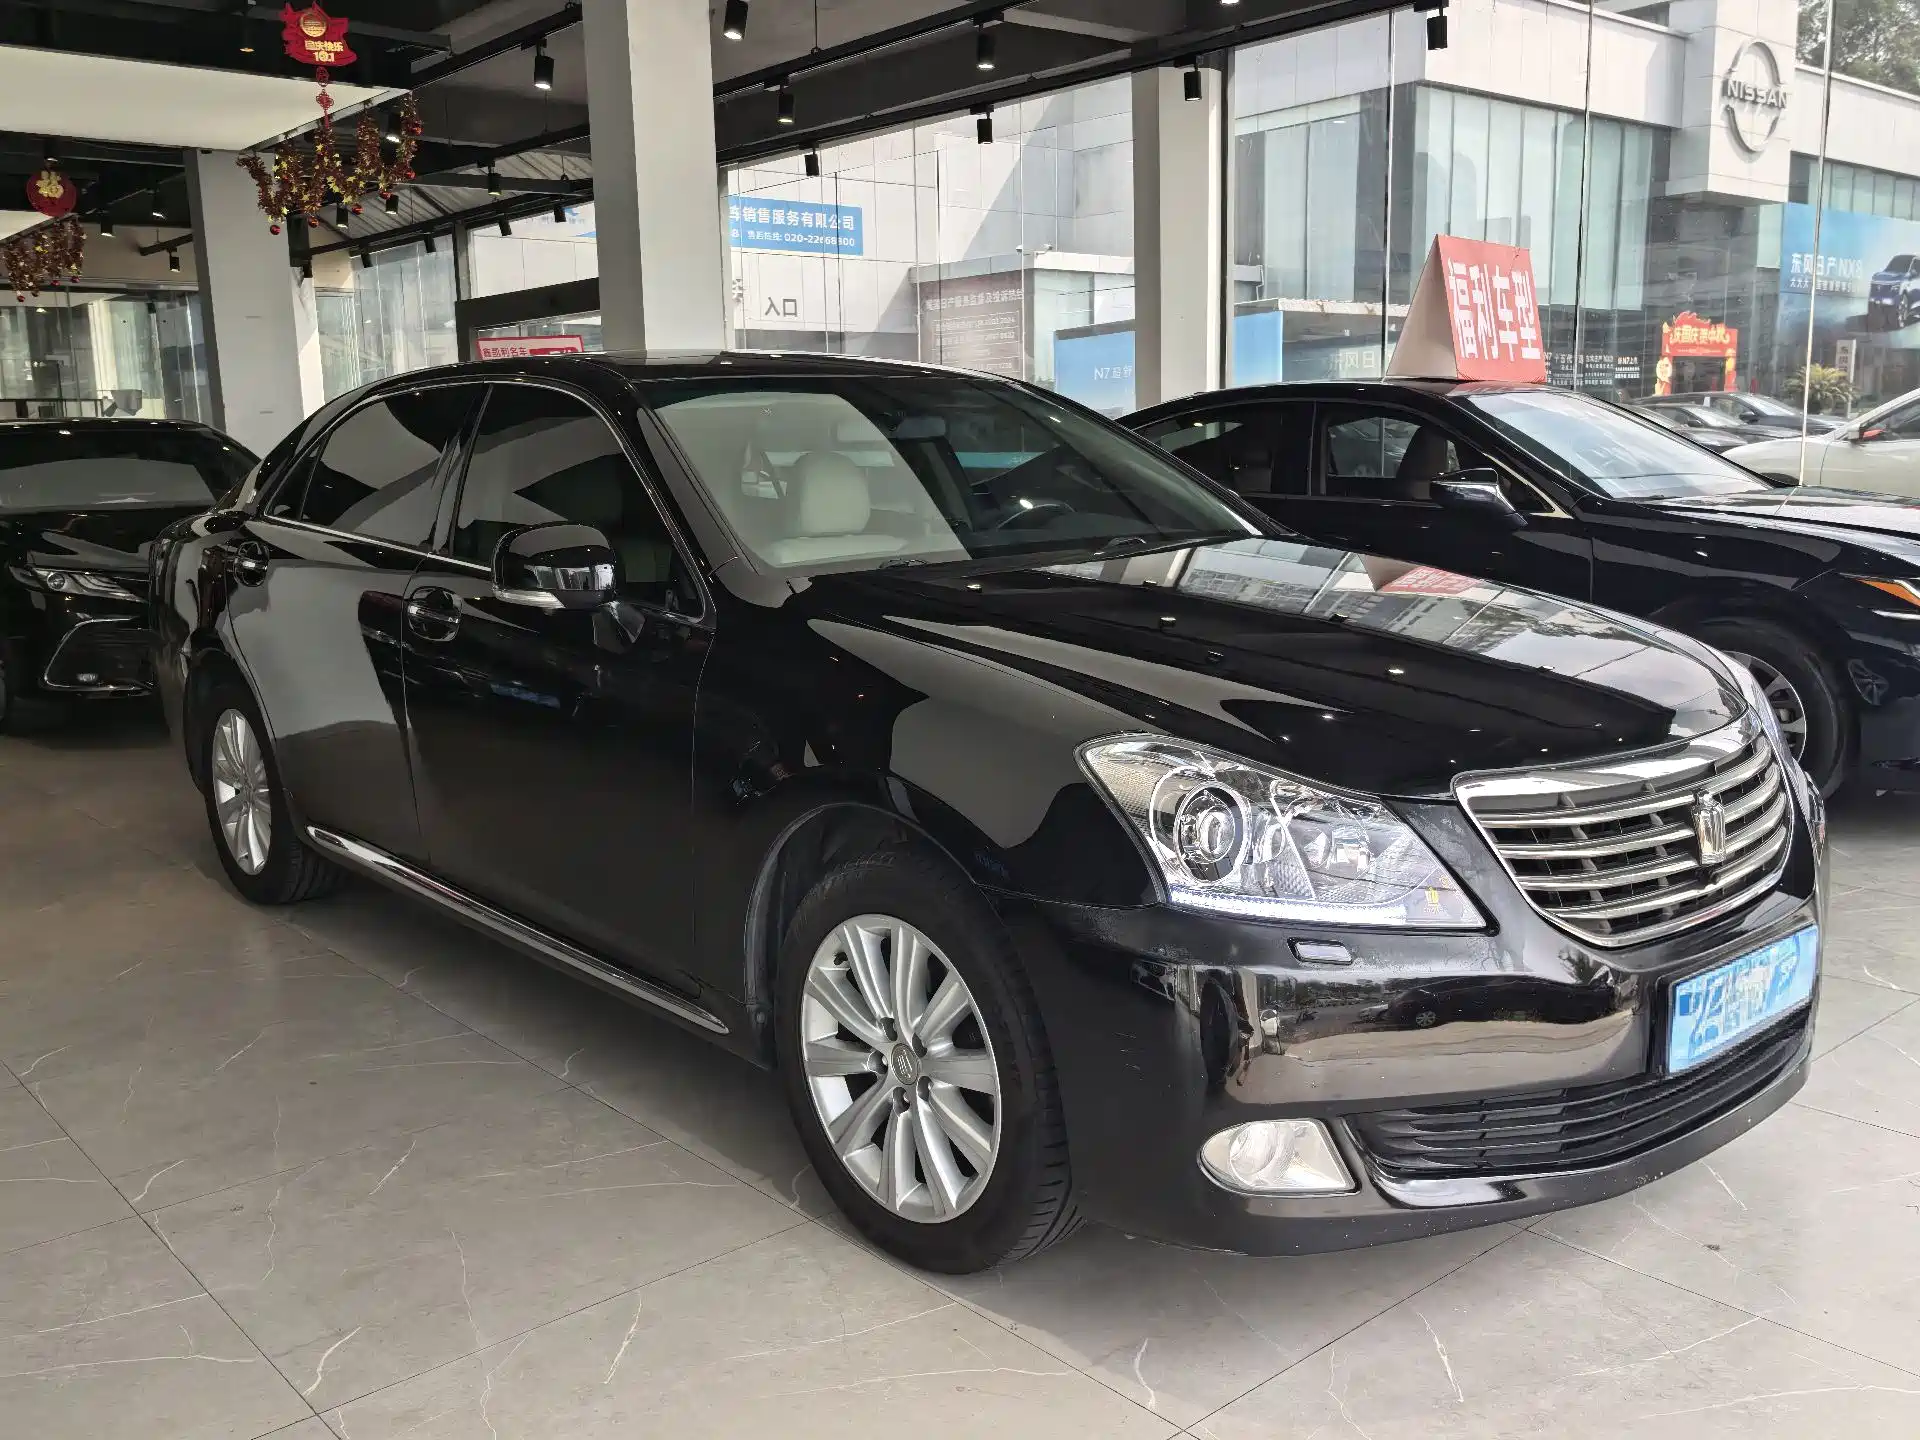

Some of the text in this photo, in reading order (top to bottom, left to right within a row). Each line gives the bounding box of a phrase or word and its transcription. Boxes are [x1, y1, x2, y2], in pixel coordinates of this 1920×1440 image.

[1723, 80, 1788, 110] NISSAN
[764, 296, 798, 318] 入口
[1447, 257, 1541, 363] 福利车型
